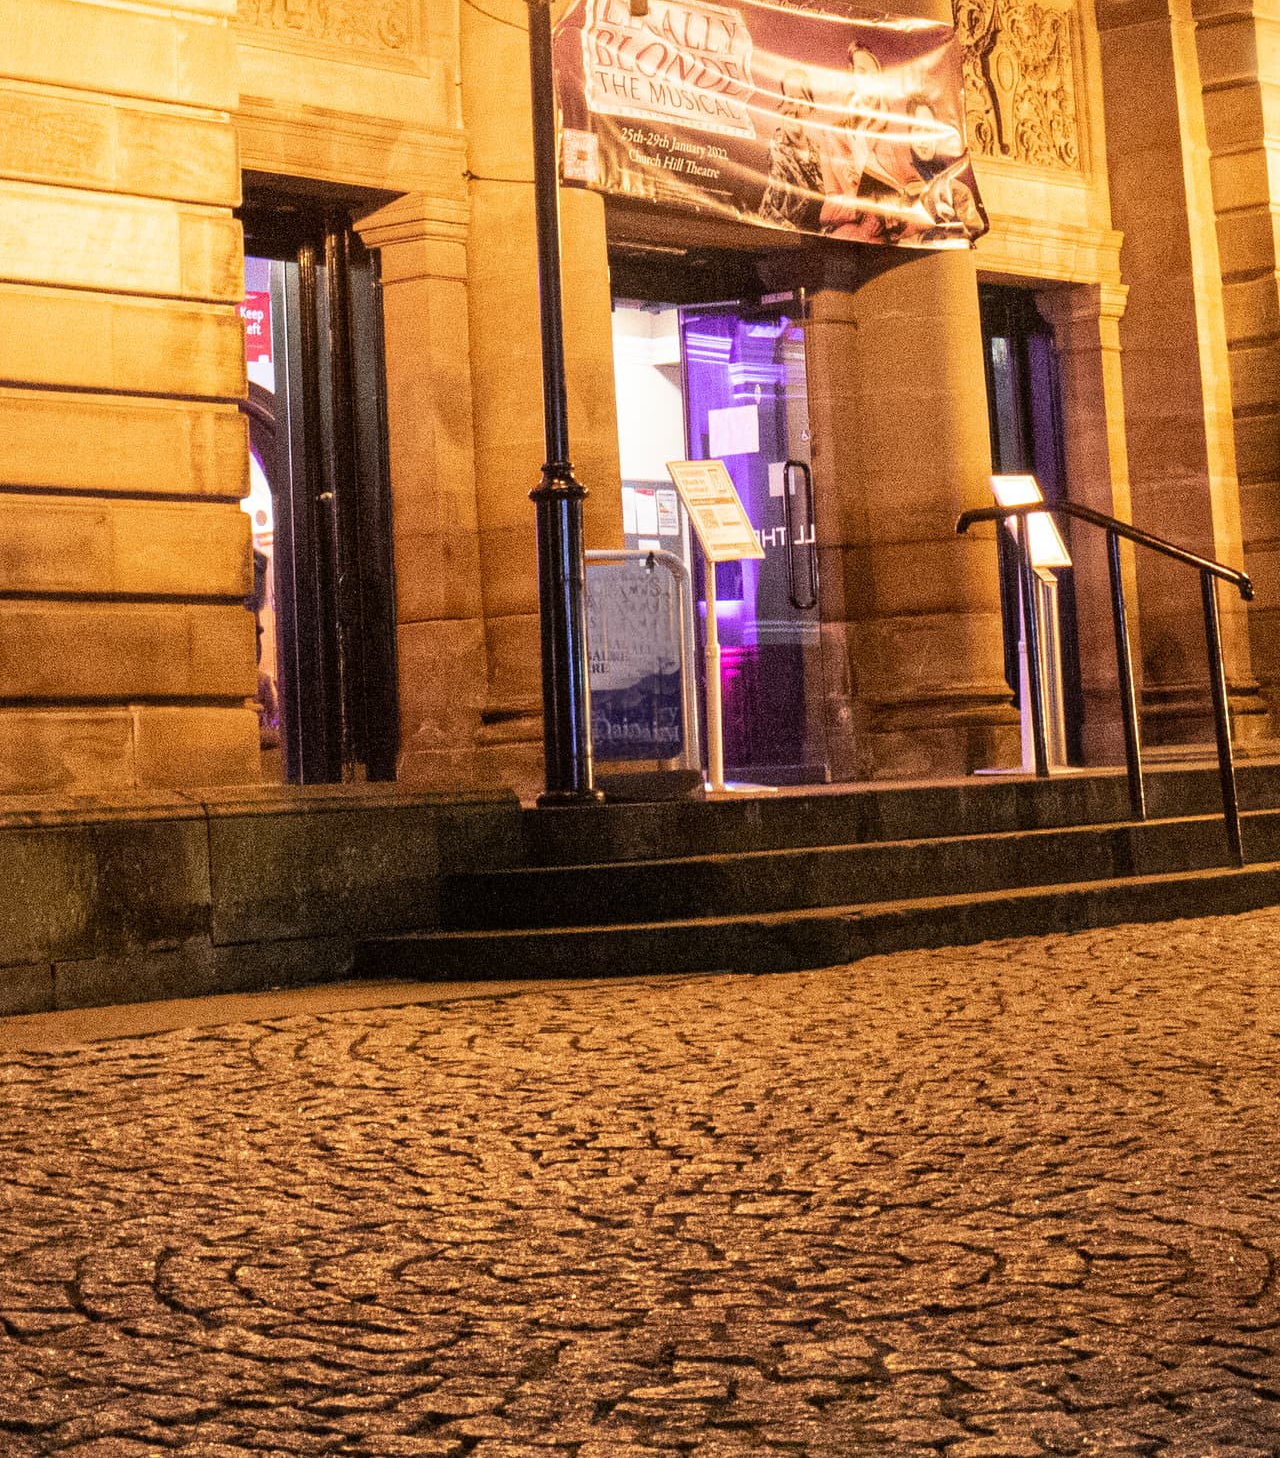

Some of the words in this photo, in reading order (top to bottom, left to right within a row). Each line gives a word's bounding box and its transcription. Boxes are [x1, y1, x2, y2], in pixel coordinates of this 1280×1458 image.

[596, 28, 743, 96] BLONDE
[595, 71, 641, 101] THE
[649, 80, 741, 120] MUSICAL
[620, 127, 670, 149] 25th-29th
[670, 136, 706, 159] January
[628, 148, 661, 168] Church
[662, 155, 684, 172] Hill
[685, 159, 721, 179] Theatre
[240, 306, 264, 324] Keep
[246, 322, 262, 335] eft
